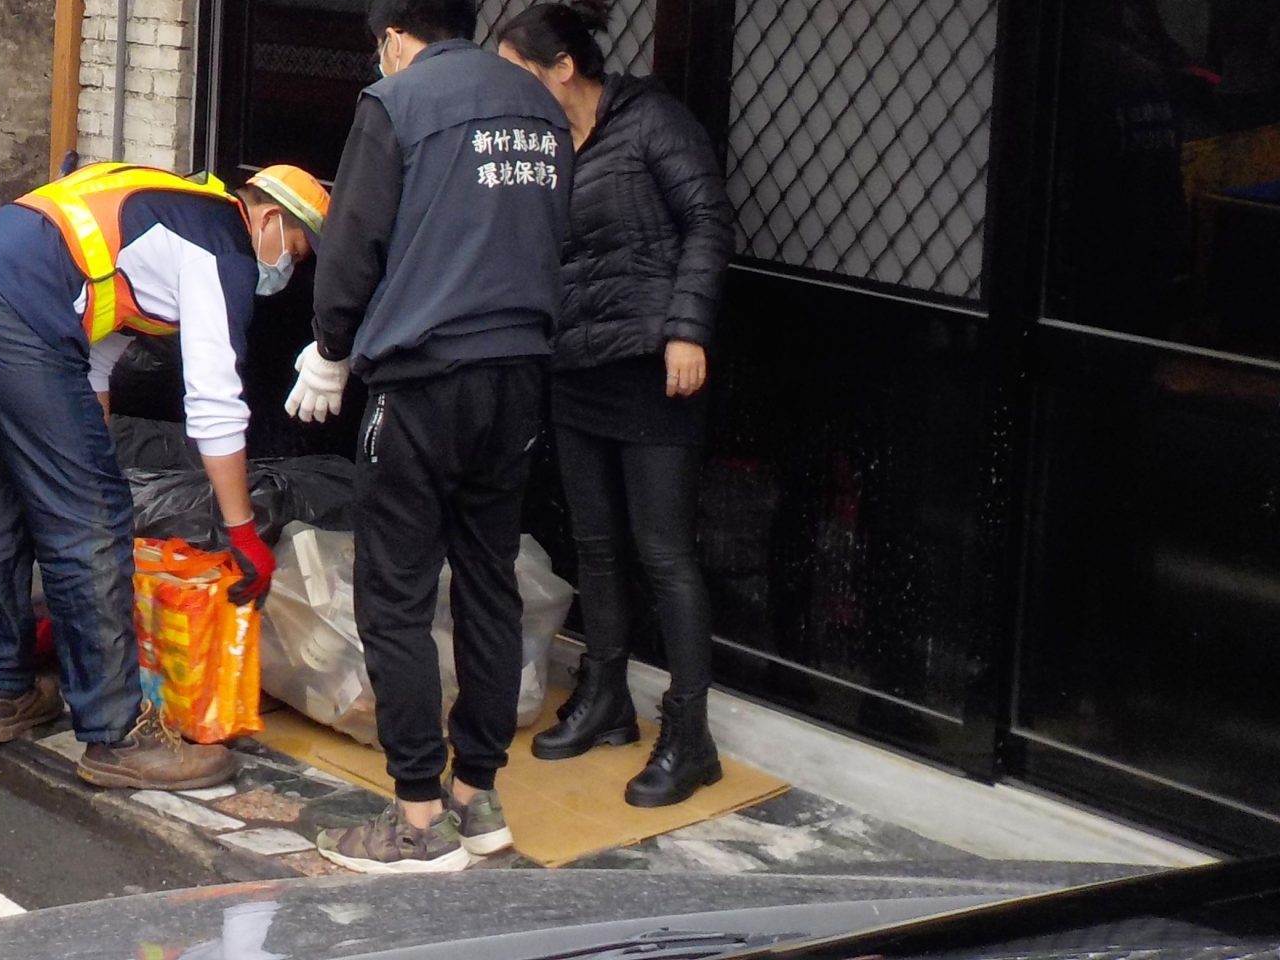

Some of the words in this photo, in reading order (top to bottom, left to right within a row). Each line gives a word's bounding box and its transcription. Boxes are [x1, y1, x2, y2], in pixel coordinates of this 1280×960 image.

[472, 128, 559, 158] 新竹縣政府
